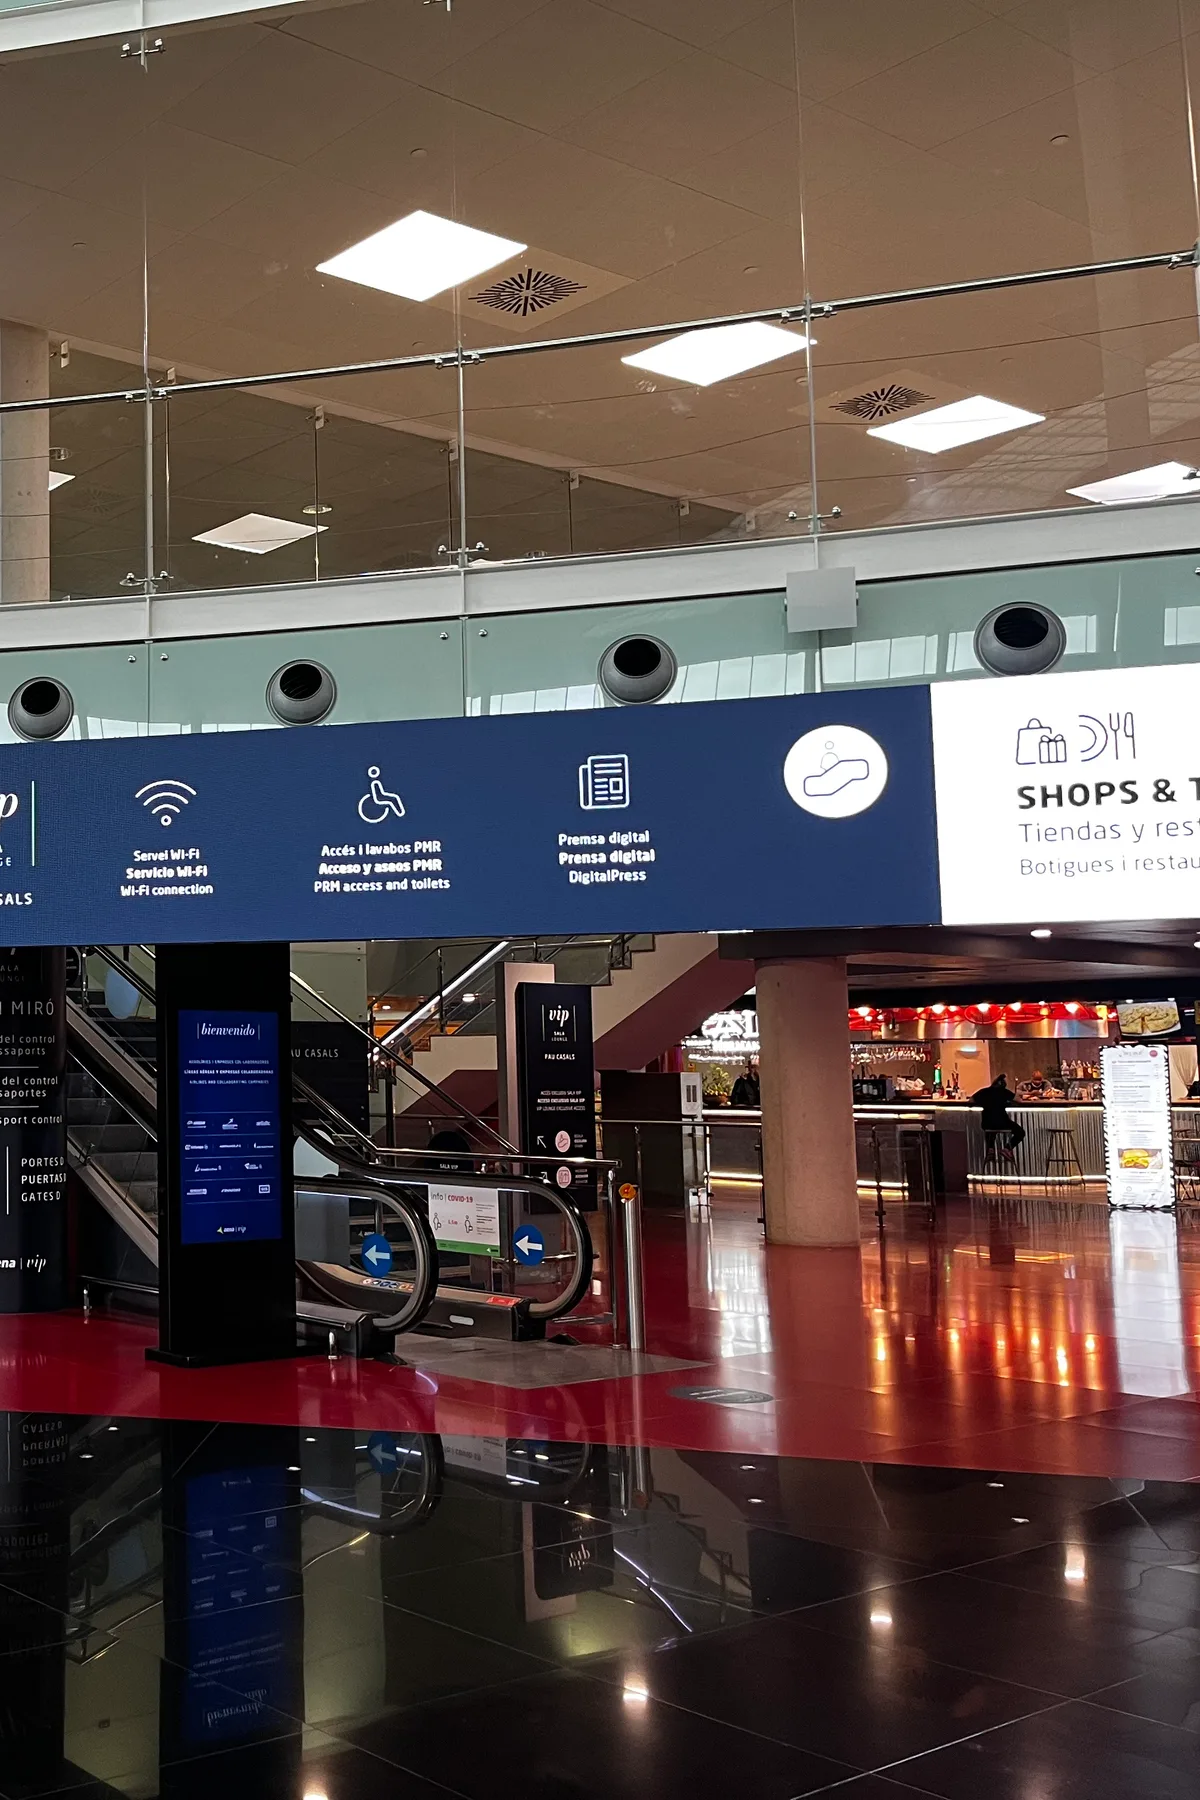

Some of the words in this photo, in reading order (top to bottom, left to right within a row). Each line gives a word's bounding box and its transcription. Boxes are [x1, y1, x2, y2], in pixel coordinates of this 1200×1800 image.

[1017, 780, 1139, 809] SHOPS
[1152, 778, 1177, 803] &
[558, 833, 606, 846] Premsa
[608, 829, 650, 846] digital
[1018, 821, 1121, 843] Tiendas
[1132, 823, 1145, 843] y
[133, 850, 169, 862] Servei
[170, 848, 200, 860] Wi-Fi
[321, 844, 356, 857] Accés
[359, 844, 363, 856] i
[365, 843, 411, 856] lavabos
[414, 840, 441, 853] PMR
[558, 852, 607, 865] Prensa
[609, 848, 656, 865] digital
[126, 867, 174, 879] Servicio
[176, 865, 208, 877] Wi-Fi
[319, 862, 361, 875] Acceso
[362, 863, 372, 875] y
[374, 861, 411, 873] aseos
[412, 859, 443, 872] PMR
[1020, 858, 1114, 878] Botigues
[1122, 855, 1126, 871] i
[569, 868, 647, 885] DigitalPress
[120, 884, 149, 897] Wi-Fi
[152, 883, 213, 896] connection
[314, 880, 340, 893] PRM
[343, 881, 383, 892] access
[385, 877, 408, 891] and
[411, 877, 451, 890] toilets
[12, 998, 54, 1016] MIRÓ
[548, 1004, 570, 1028] vip
[201, 1023, 255, 1036] bienvenido
[19, 1035, 56, 1044] control
[304, 1048, 339, 1058] CASALS
[1, 1076, 20, 1086] del
[24, 1076, 58, 1085] control
[31, 1115, 63, 1124] control
[21, 1157, 59, 1168] PORTES
[21, 1173, 63, 1185] PUERTAS
[21, 1191, 54, 1202] GATES
[55, 1191, 61, 1200] D
[430, 1192, 444, 1201] info
[447, 1194, 473, 1203] COVID-19
[26, 1254, 47, 1273] vip
